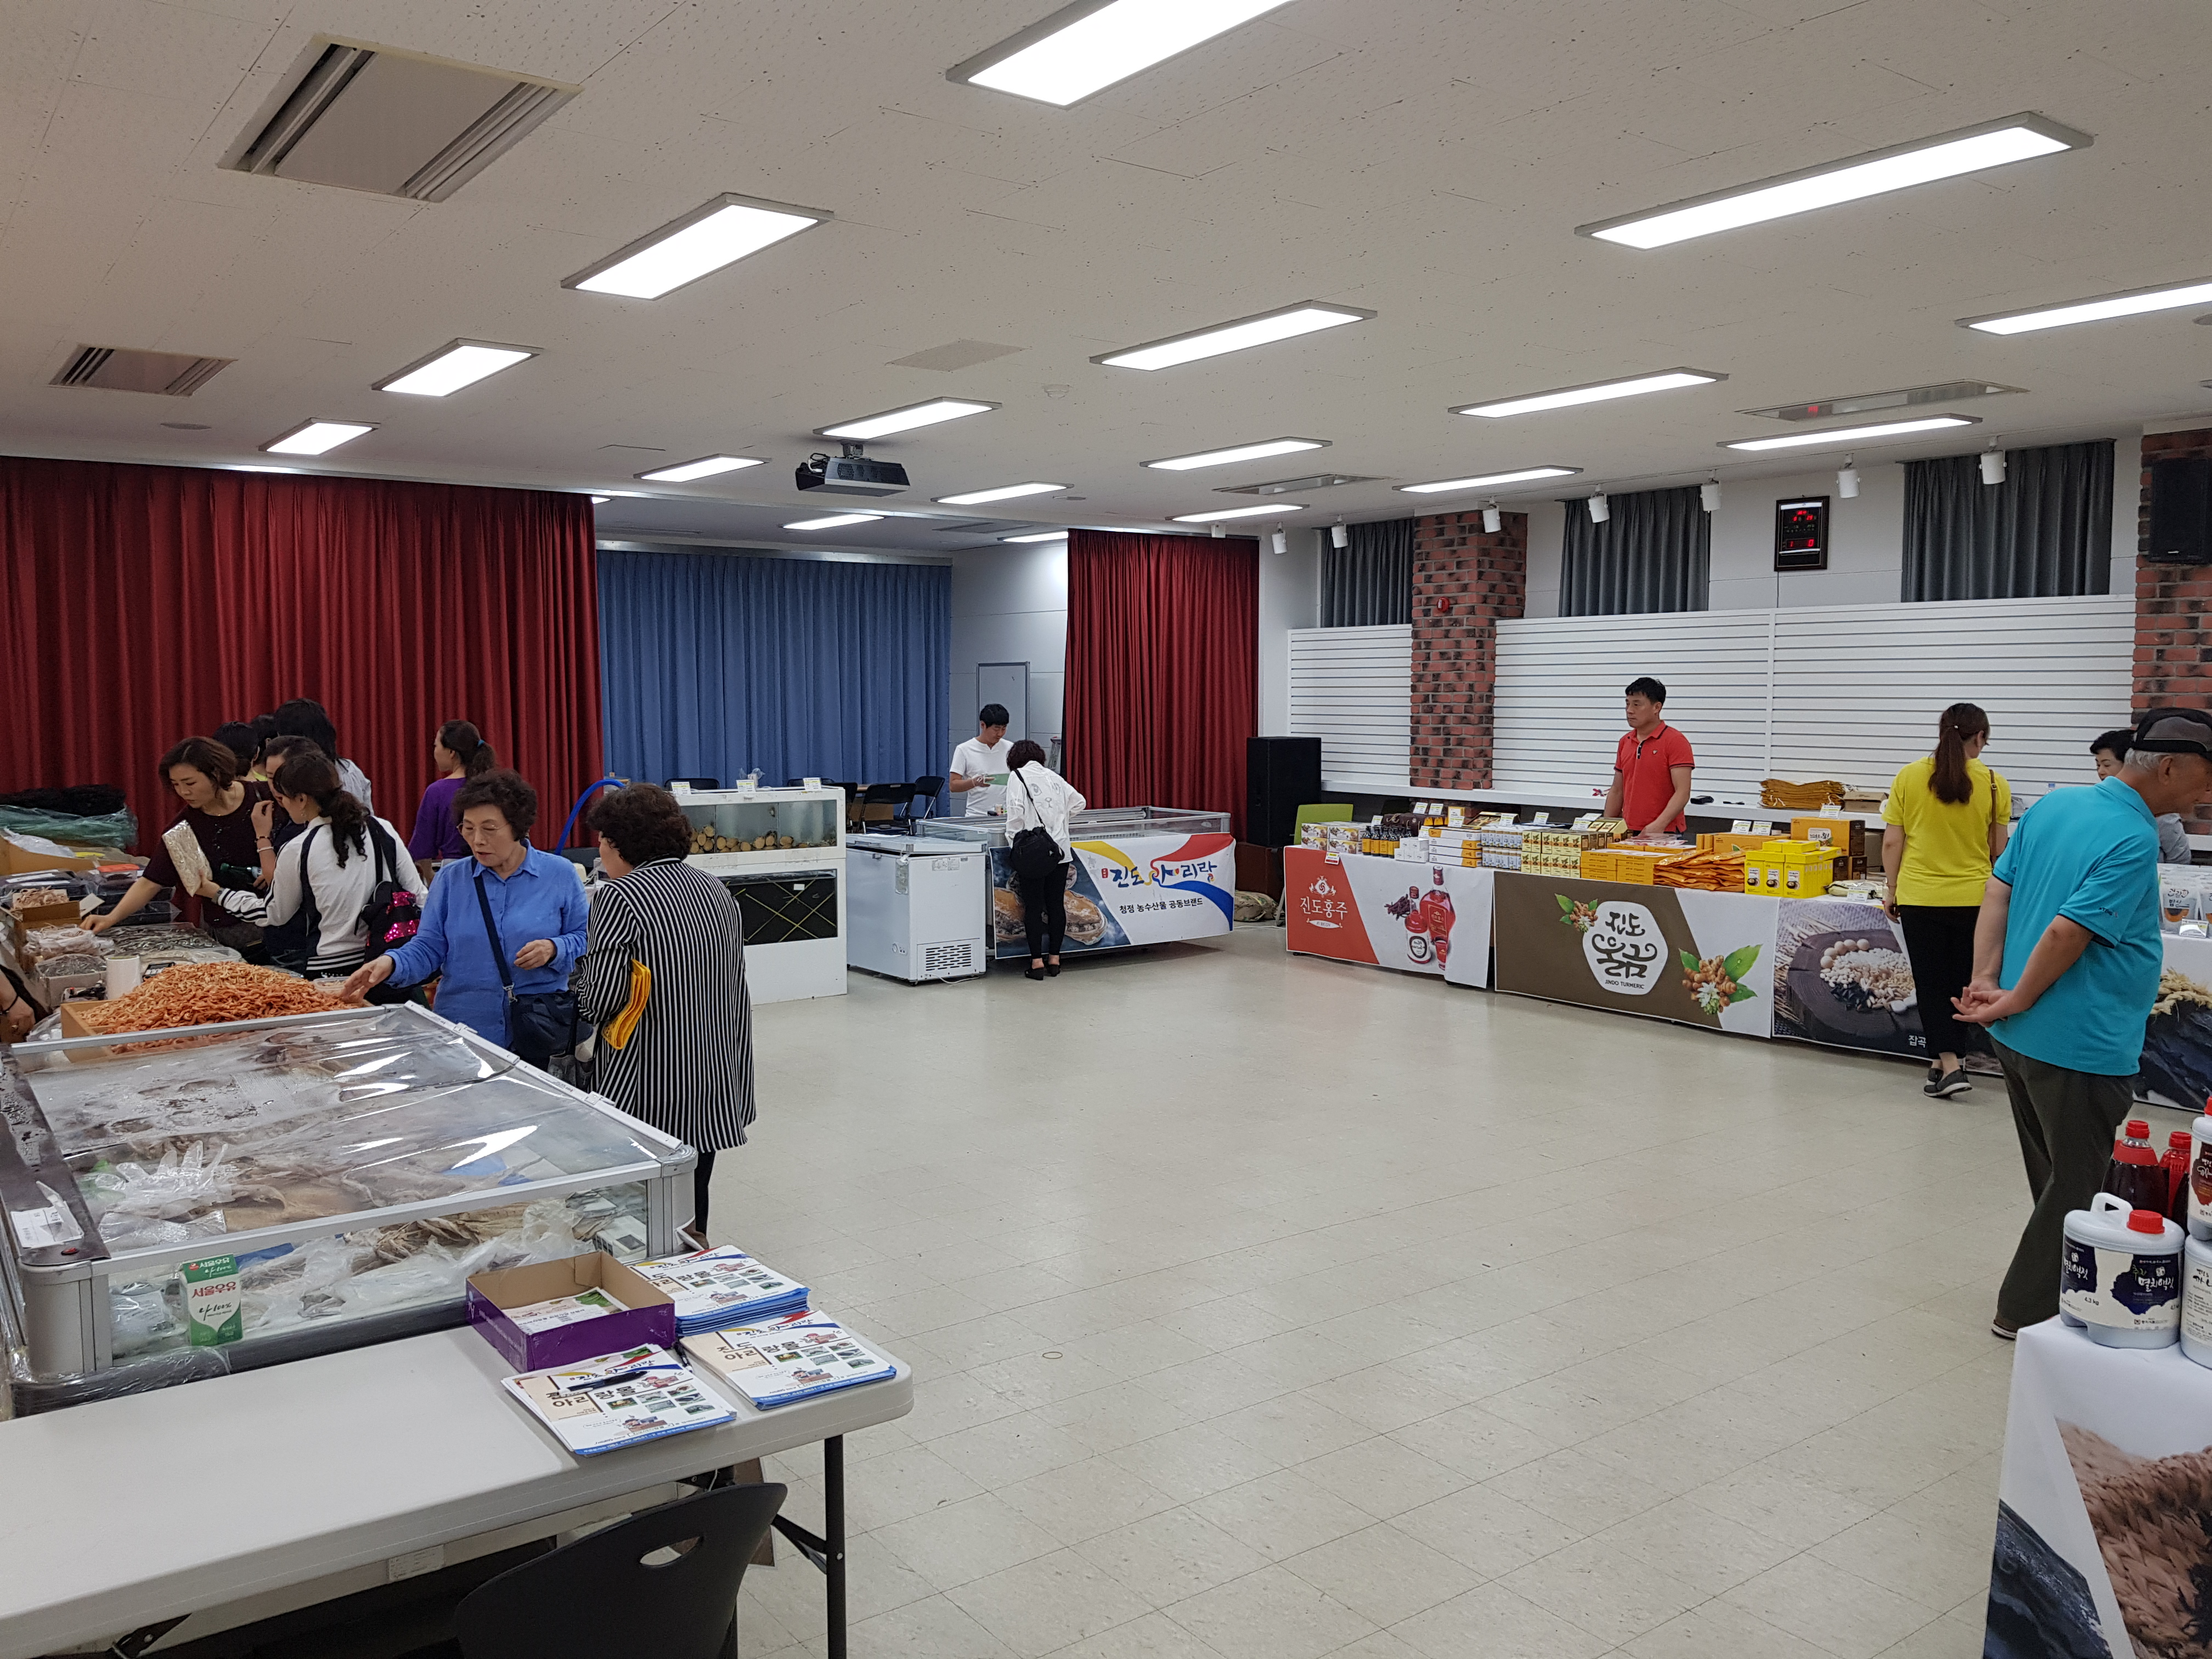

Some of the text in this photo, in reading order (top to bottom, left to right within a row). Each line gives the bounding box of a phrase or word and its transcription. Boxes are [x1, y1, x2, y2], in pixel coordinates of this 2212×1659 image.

[1110, 861, 1217, 888] 진도아리랑
[1119, 898, 1203, 914] 청정 농수산물 공동브랜드
[1300, 896, 1348, 920] 진도홍주
[1605, 912, 1645, 936] 진도
[1592, 934, 1657, 979] 울금
[1620, 981, 1645, 989] TURMERIC
[1908, 1035, 1927, 1048] 잡곡
[200, 1257, 230, 1268] 서울우유
[191, 1282, 236, 1299] 서울우유
[724, 1350, 758, 1360] 아리
[552, 1396, 589, 1407] 아리
